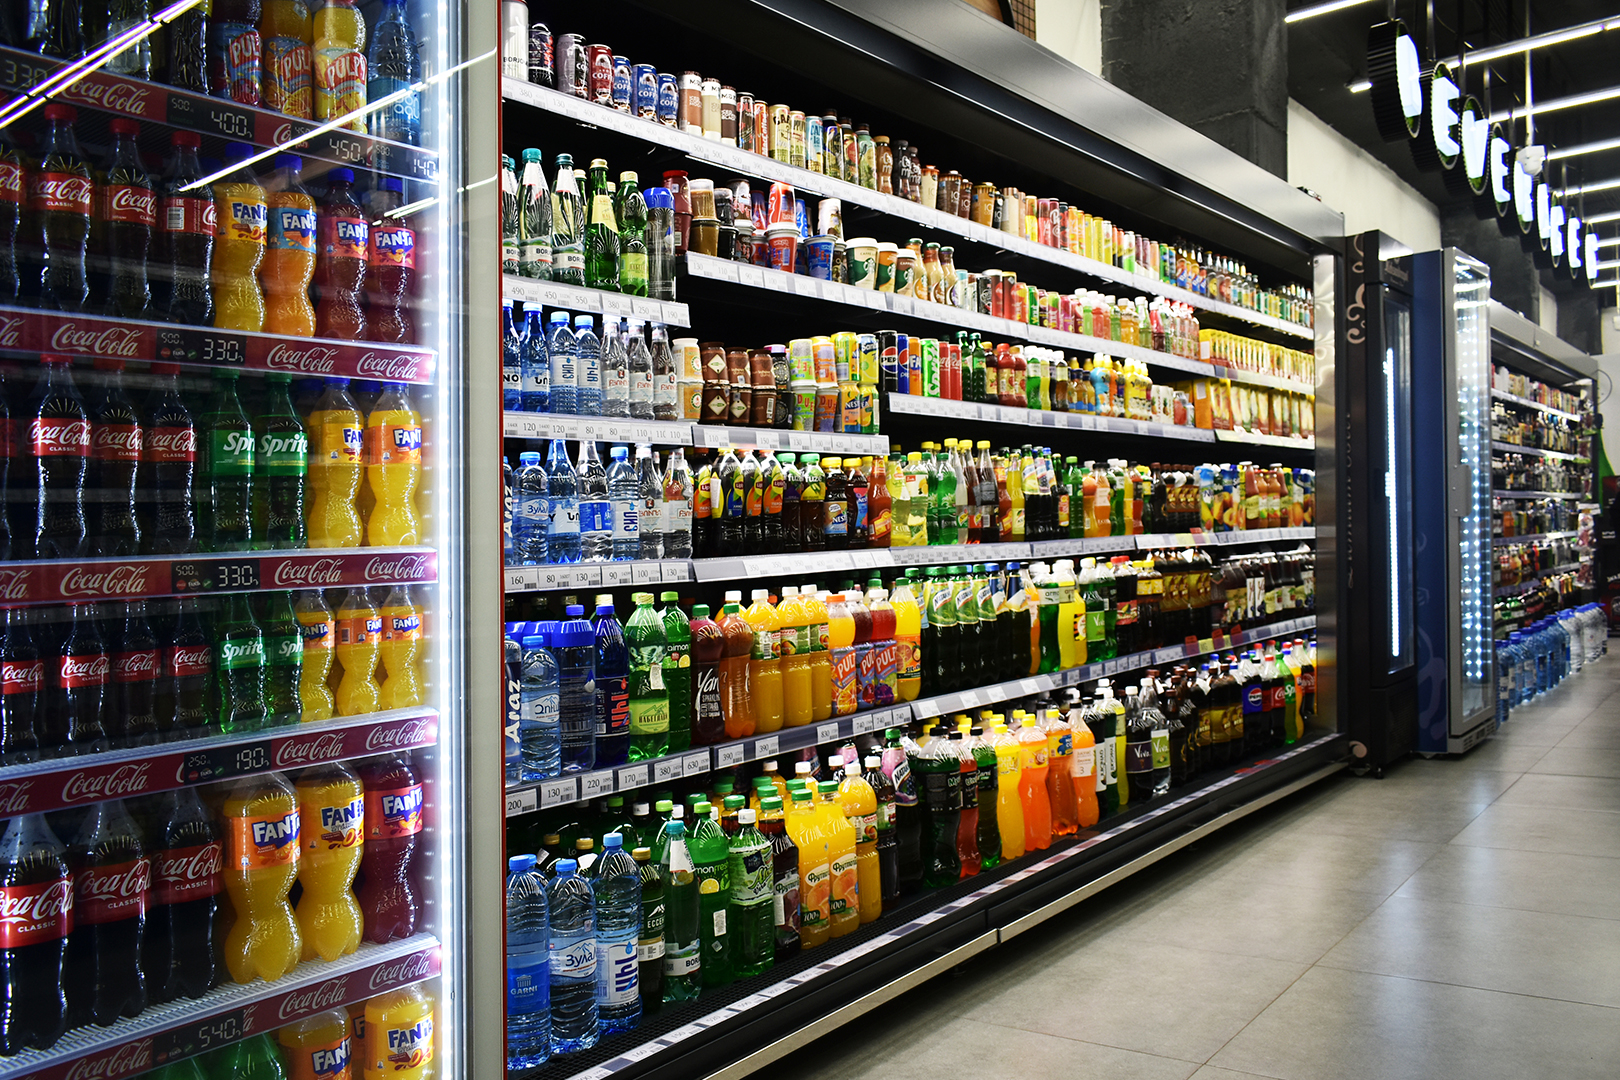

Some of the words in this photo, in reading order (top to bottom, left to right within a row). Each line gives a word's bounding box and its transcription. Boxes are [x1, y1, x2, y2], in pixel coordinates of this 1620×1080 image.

[592, 72, 612, 80] COFF
[638, 90, 656, 98] COFF
[660, 99, 678, 107] COFF
[211, 110, 247, 137] 400
[329, 138, 361, 162] 450
[338, 221, 368, 238] FANT
[375, 230, 413, 246] FANTA
[511, 287, 525, 295] 490
[545, 291, 557, 300] 450
[575, 296, 587, 305] 550
[638, 306, 649, 314] 250
[52, 322, 144, 356] Coca-Cola
[203, 338, 238, 361] 330
[267, 343, 339, 372] Coca-Cola
[357, 352, 422, 379] Coca-Cola
[503, 374, 519, 383] NO
[27, 421, 92, 446] Coca-Cola
[523, 423, 536, 431] 120
[553, 425, 565, 433] 120
[586, 426, 594, 434] 80
[637, 429, 647, 437] 110
[344, 428, 363, 443] FAN
[394, 429, 421, 445] FANT
[223, 432, 255, 455] Spr
[805, 474, 822, 483] fuze
[504, 486, 513, 539] Araz
[274, 558, 344, 585] Coca-Cola
[364, 555, 428, 580] Coca-Cola
[637, 570, 648, 578] 100
[666, 568, 677, 577] 130
[60, 566, 150, 596] Coca-Cola
[218, 566, 253, 587] 330
[511, 576, 524, 585] 160
[547, 575, 555, 583] 80
[576, 573, 588, 581] 130
[609, 572, 617, 580] 90
[366, 618, 382, 631] FAN
[392, 617, 420, 630] FANTA
[221, 640, 263, 660] Sprite
[838, 649, 856, 678] PUL
[876, 646, 897, 672] PULP
[505, 679, 521, 744] Araz
[365, 718, 429, 750] Coca-Cola
[821, 729, 830, 738] 830
[276, 732, 347, 766] Coca-Cola
[759, 745, 769, 753] 390
[237, 748, 264, 770] 190
[723, 752, 733, 760] 390
[660, 766, 670, 776] 380
[688, 761, 698, 769] 630
[62, 762, 152, 802] Coca-Cola
[587, 779, 600, 788] 220
[624, 774, 635, 783] 170
[547, 788, 560, 798] 130
[508, 800, 521, 810] 200
[152, 844, 223, 882] Coca-Cola
[175, 880, 208, 891] CLASSIC
[0, 879, 74, 924] oca-Cola
[108, 897, 141, 909] CLASSIC
[18, 920, 56, 933] CLASSIC
[566, 953, 594, 968] Зула
[369, 950, 431, 988] Coca-Cola
[511, 985, 538, 996] GARNI
[279, 976, 348, 1019] Coca-Cola
[200, 1018, 237, 1049] 540
[313, 1037, 351, 1071] FANT
